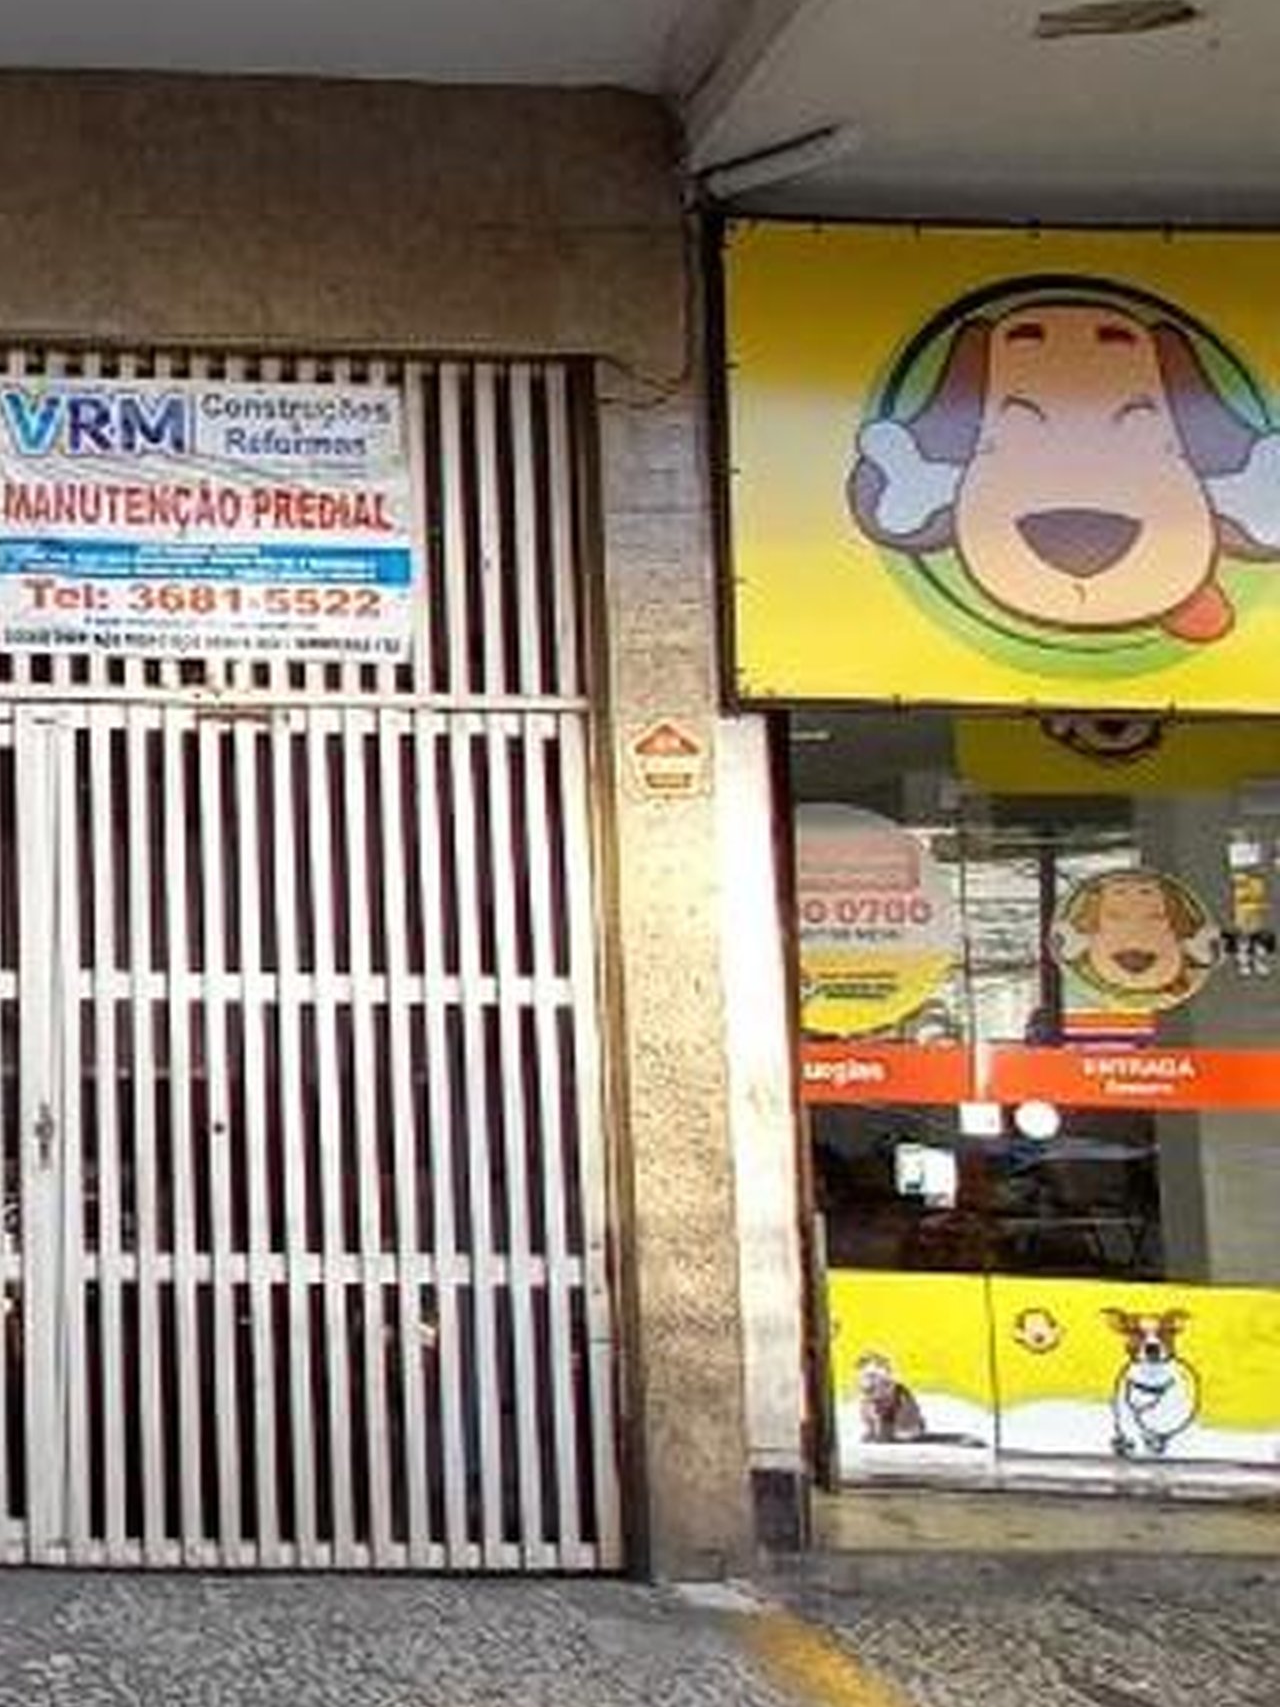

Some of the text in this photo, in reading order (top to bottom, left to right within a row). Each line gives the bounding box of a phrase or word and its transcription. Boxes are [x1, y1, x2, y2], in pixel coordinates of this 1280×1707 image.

[3, 391, 187, 455] VRM
[201, 392, 391, 428] Construções
[224, 427, 367, 455] Reformas
[3, 478, 394, 536] MANUTENÇÃO PREDIAL
[22, 577, 381, 618] Tel: 3681-5522
